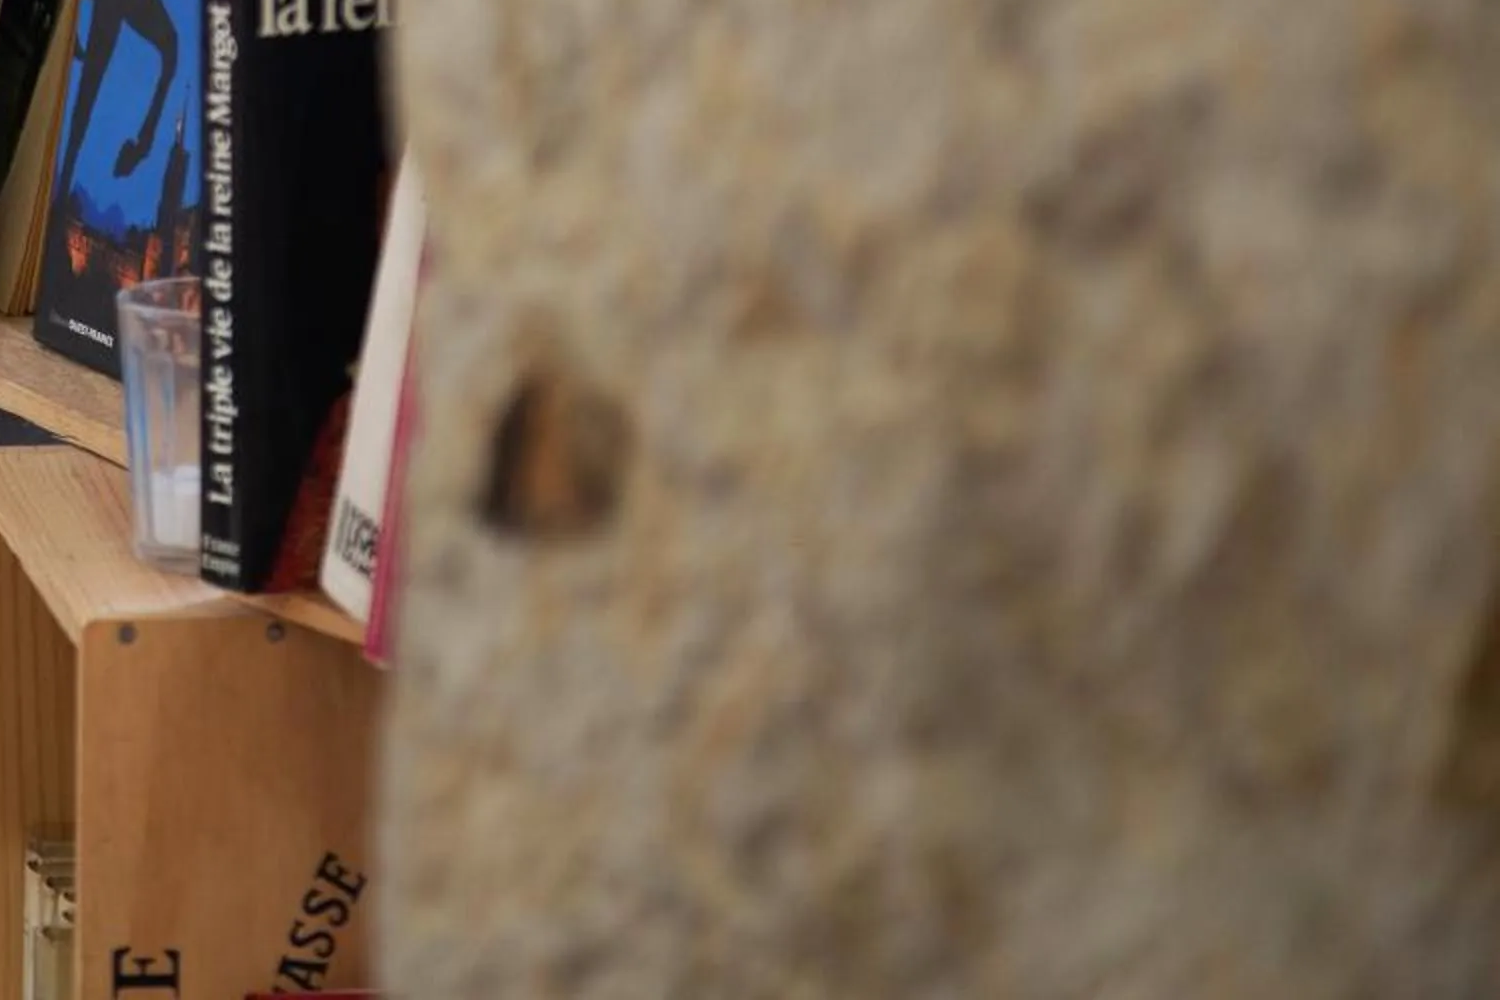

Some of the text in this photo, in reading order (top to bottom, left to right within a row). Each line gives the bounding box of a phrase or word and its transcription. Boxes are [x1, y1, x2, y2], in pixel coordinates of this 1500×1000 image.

[206, 2, 238, 506] La triple vie de la reine Margot
[270, 850, 368, 993] ASSE
